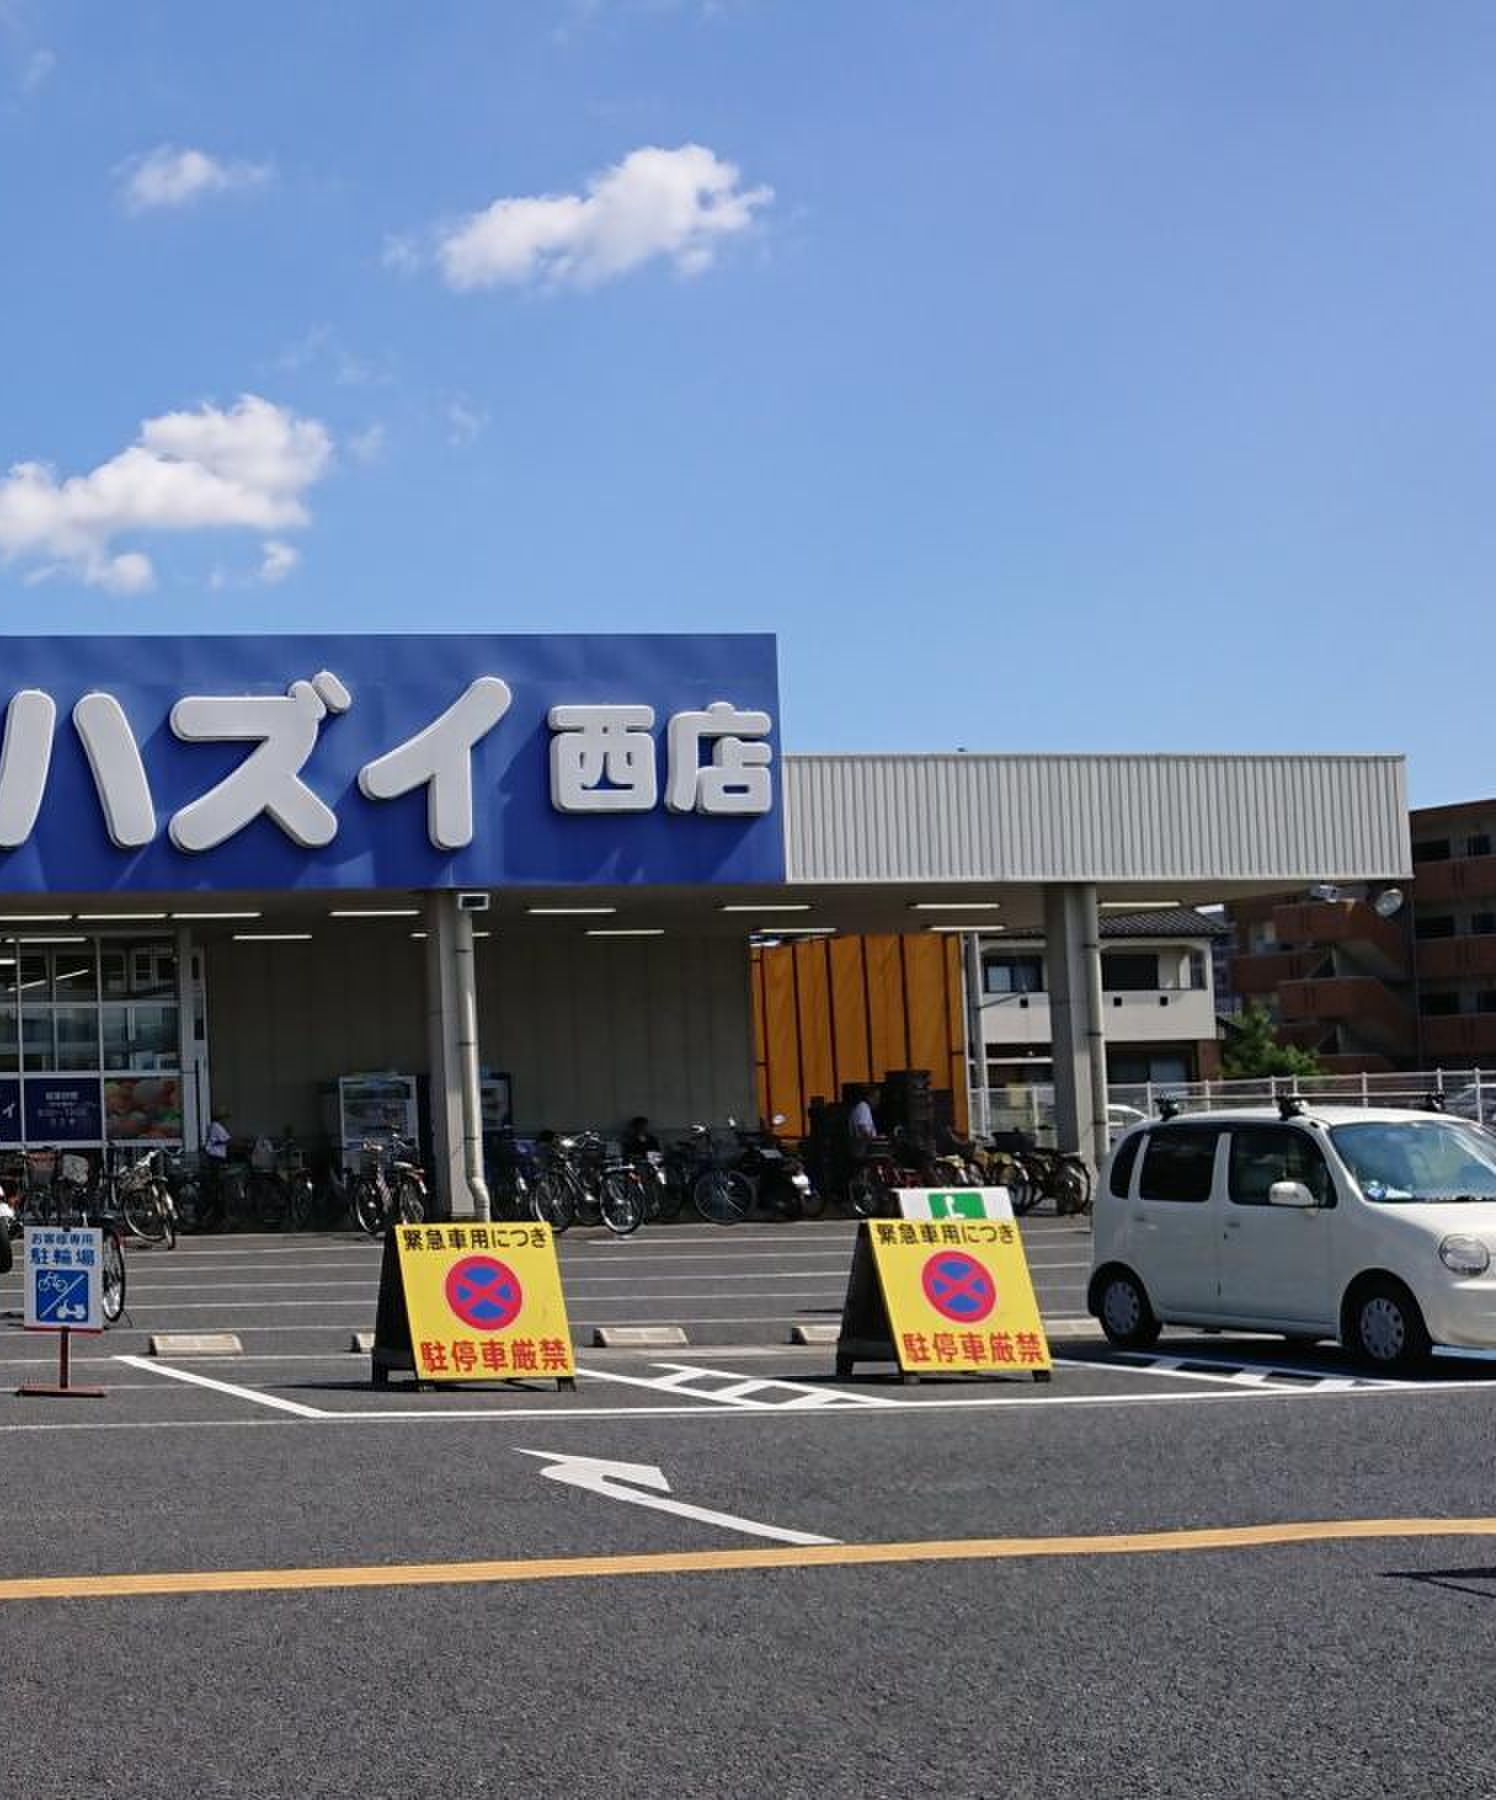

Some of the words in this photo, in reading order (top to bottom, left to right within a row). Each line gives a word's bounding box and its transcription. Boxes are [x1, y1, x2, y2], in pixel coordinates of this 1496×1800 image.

[549, 702, 773, 815] 西店
[402, 1227, 547, 1251] 緊急車用につき
[876, 1223, 1015, 1245] 緊急車用につき
[29, 1247, 96, 1266] 駐輪場
[419, 1338, 569, 1373] 駐停車厳禁
[902, 1330, 1045, 1364] 駐停車厳禁
